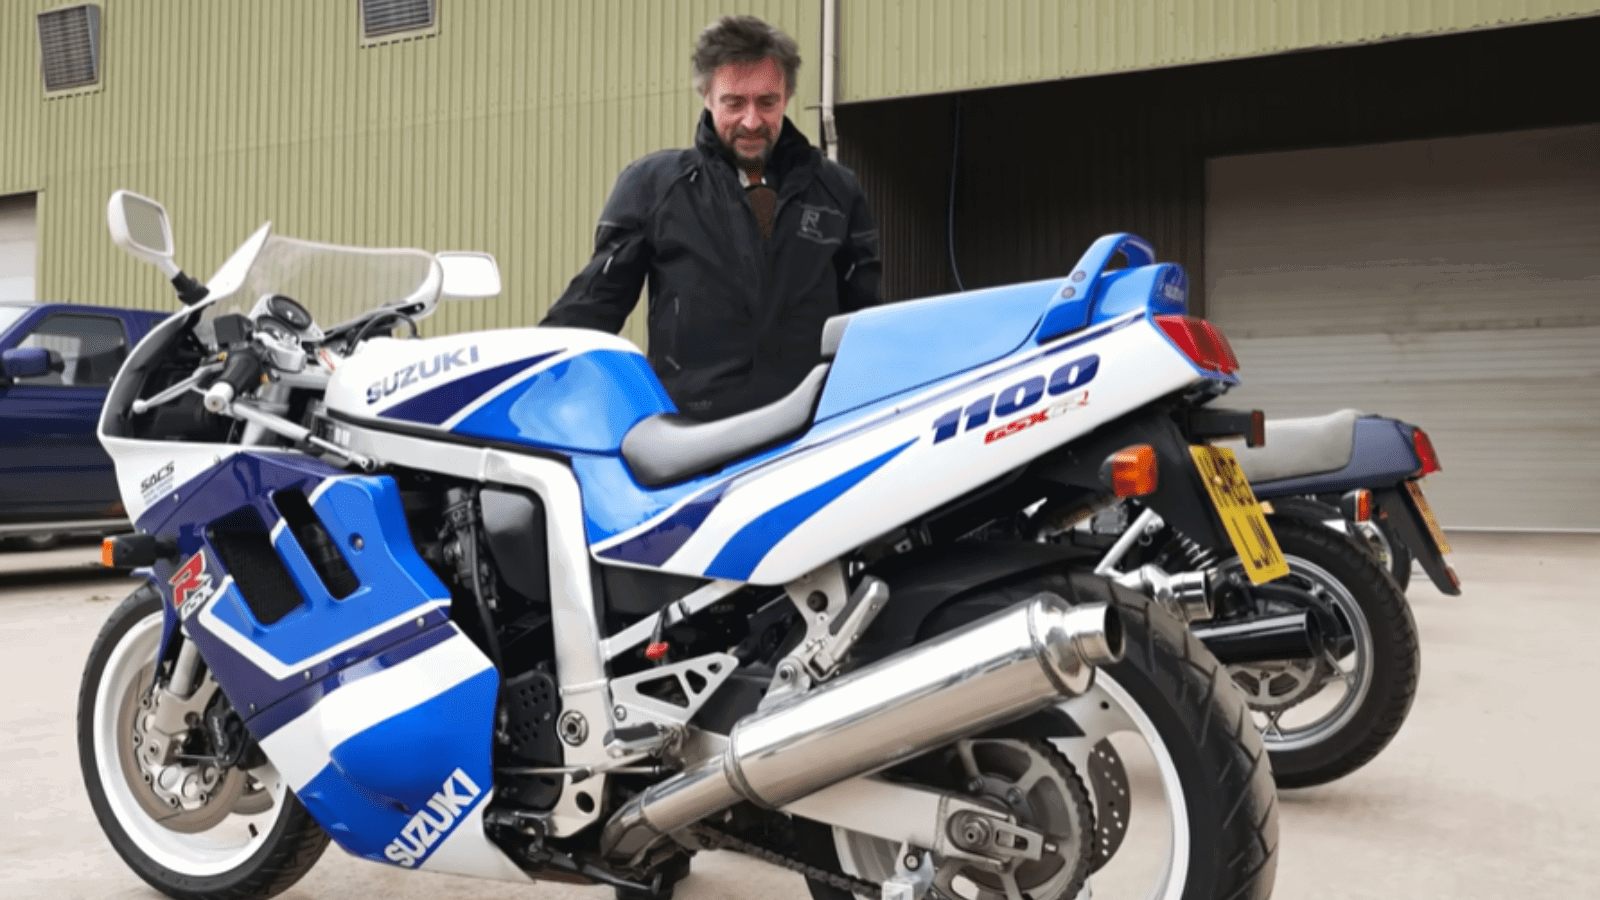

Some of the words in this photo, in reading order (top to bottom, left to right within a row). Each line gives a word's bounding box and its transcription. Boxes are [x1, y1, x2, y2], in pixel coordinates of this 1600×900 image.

[367, 345, 480, 406] SUZUKI
[932, 353, 1101, 445] 1100
[140, 460, 175, 494] SACS
[169, 549, 206, 607] R
[384, 767, 482, 867] SUZUKI
